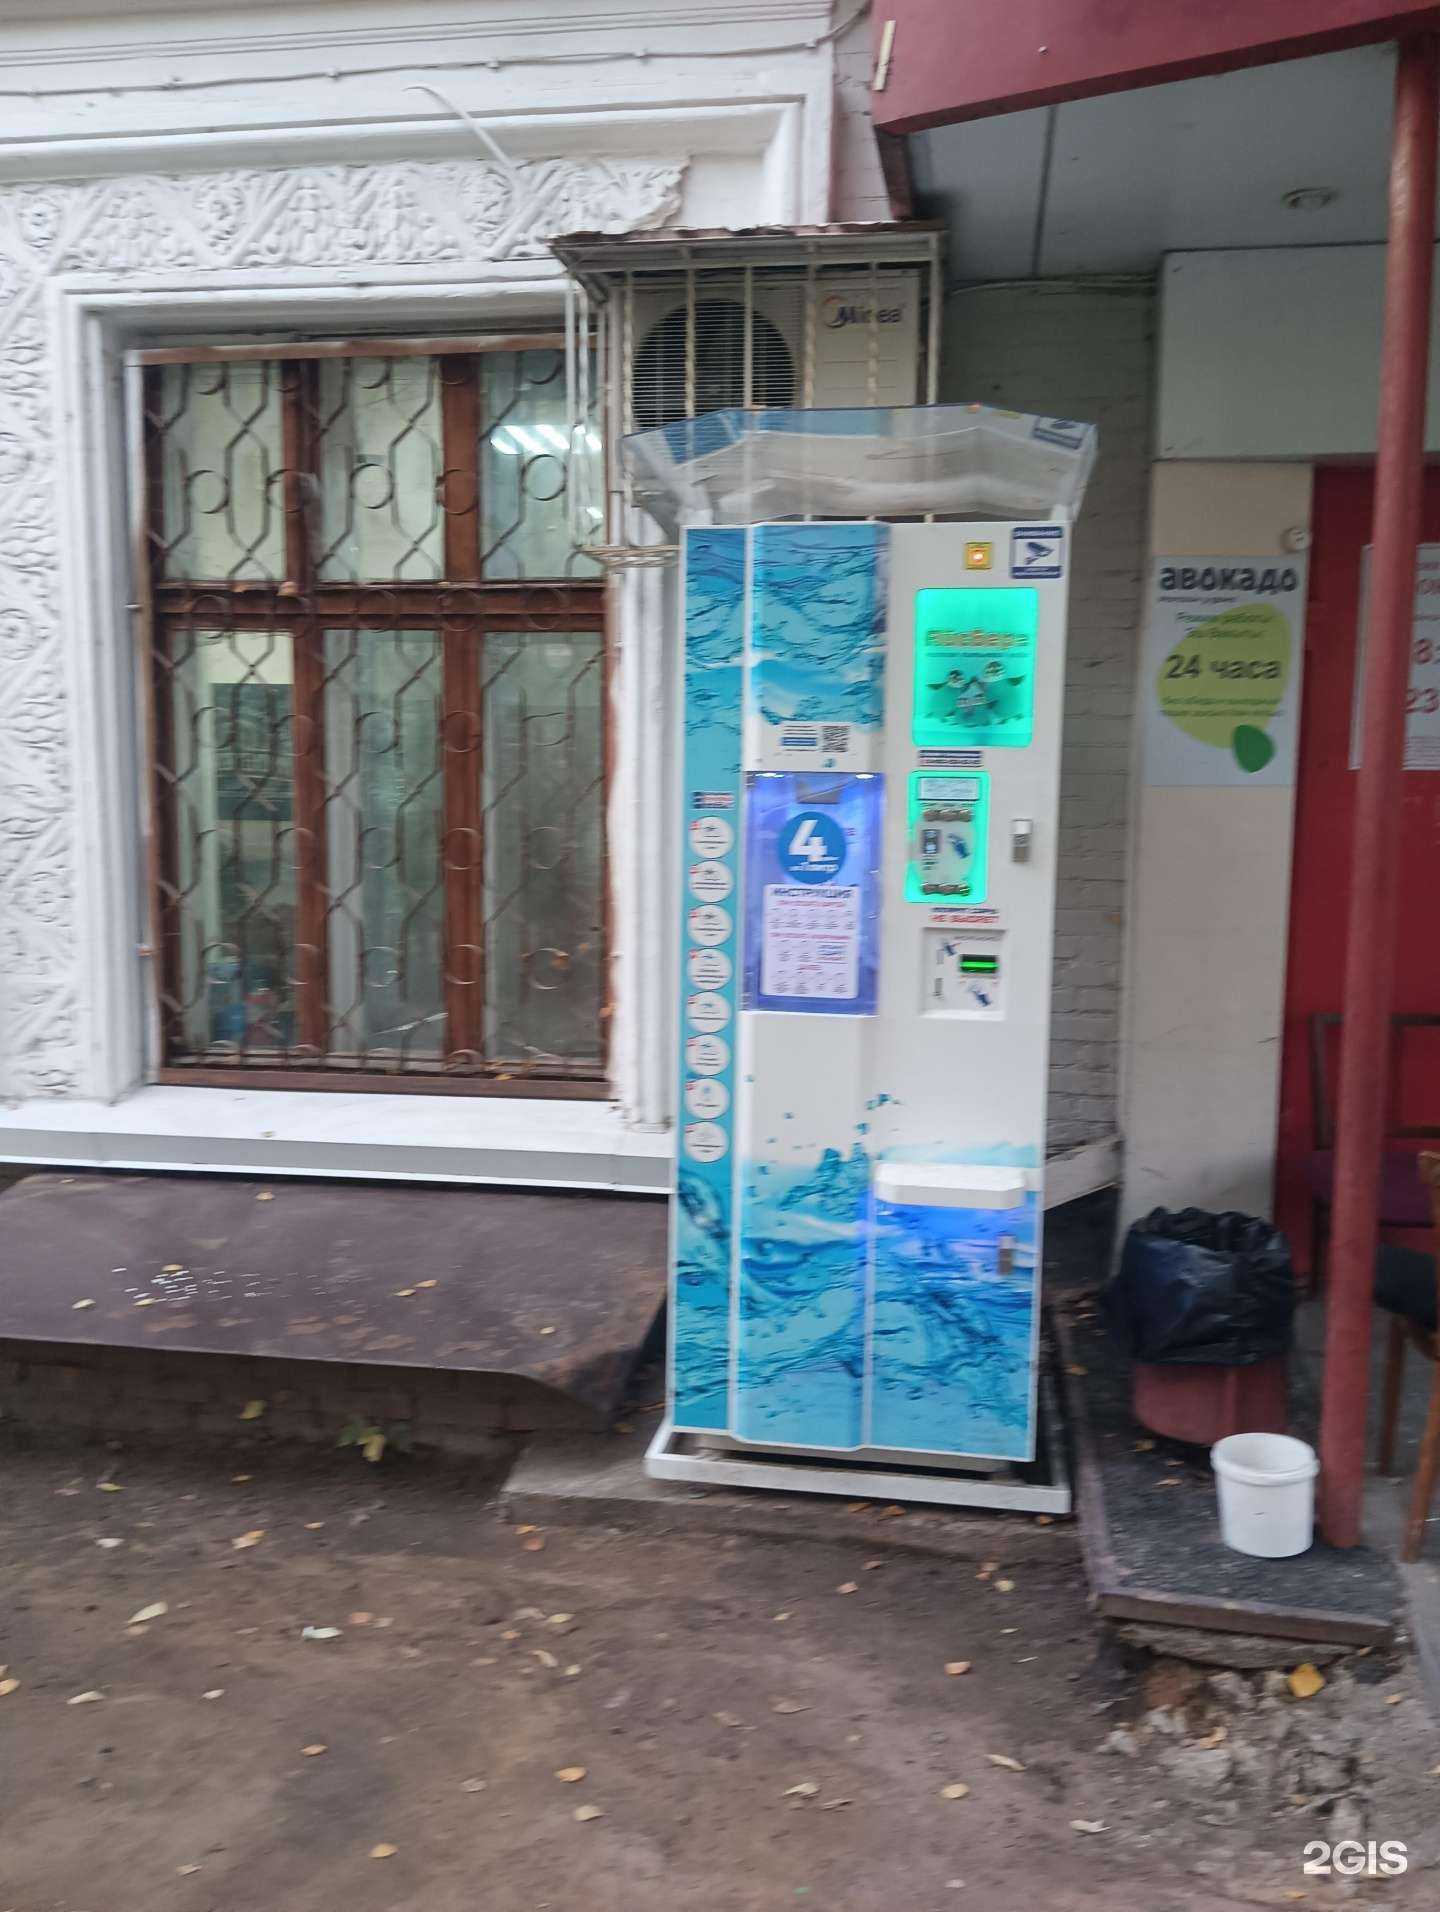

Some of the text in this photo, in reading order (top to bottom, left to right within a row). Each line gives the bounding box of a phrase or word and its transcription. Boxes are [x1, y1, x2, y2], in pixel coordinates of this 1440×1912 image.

[1160, 566, 1298, 595] авокадо
[1164, 654, 1281, 679] 24 часа
[788, 819, 828, 862] 4
